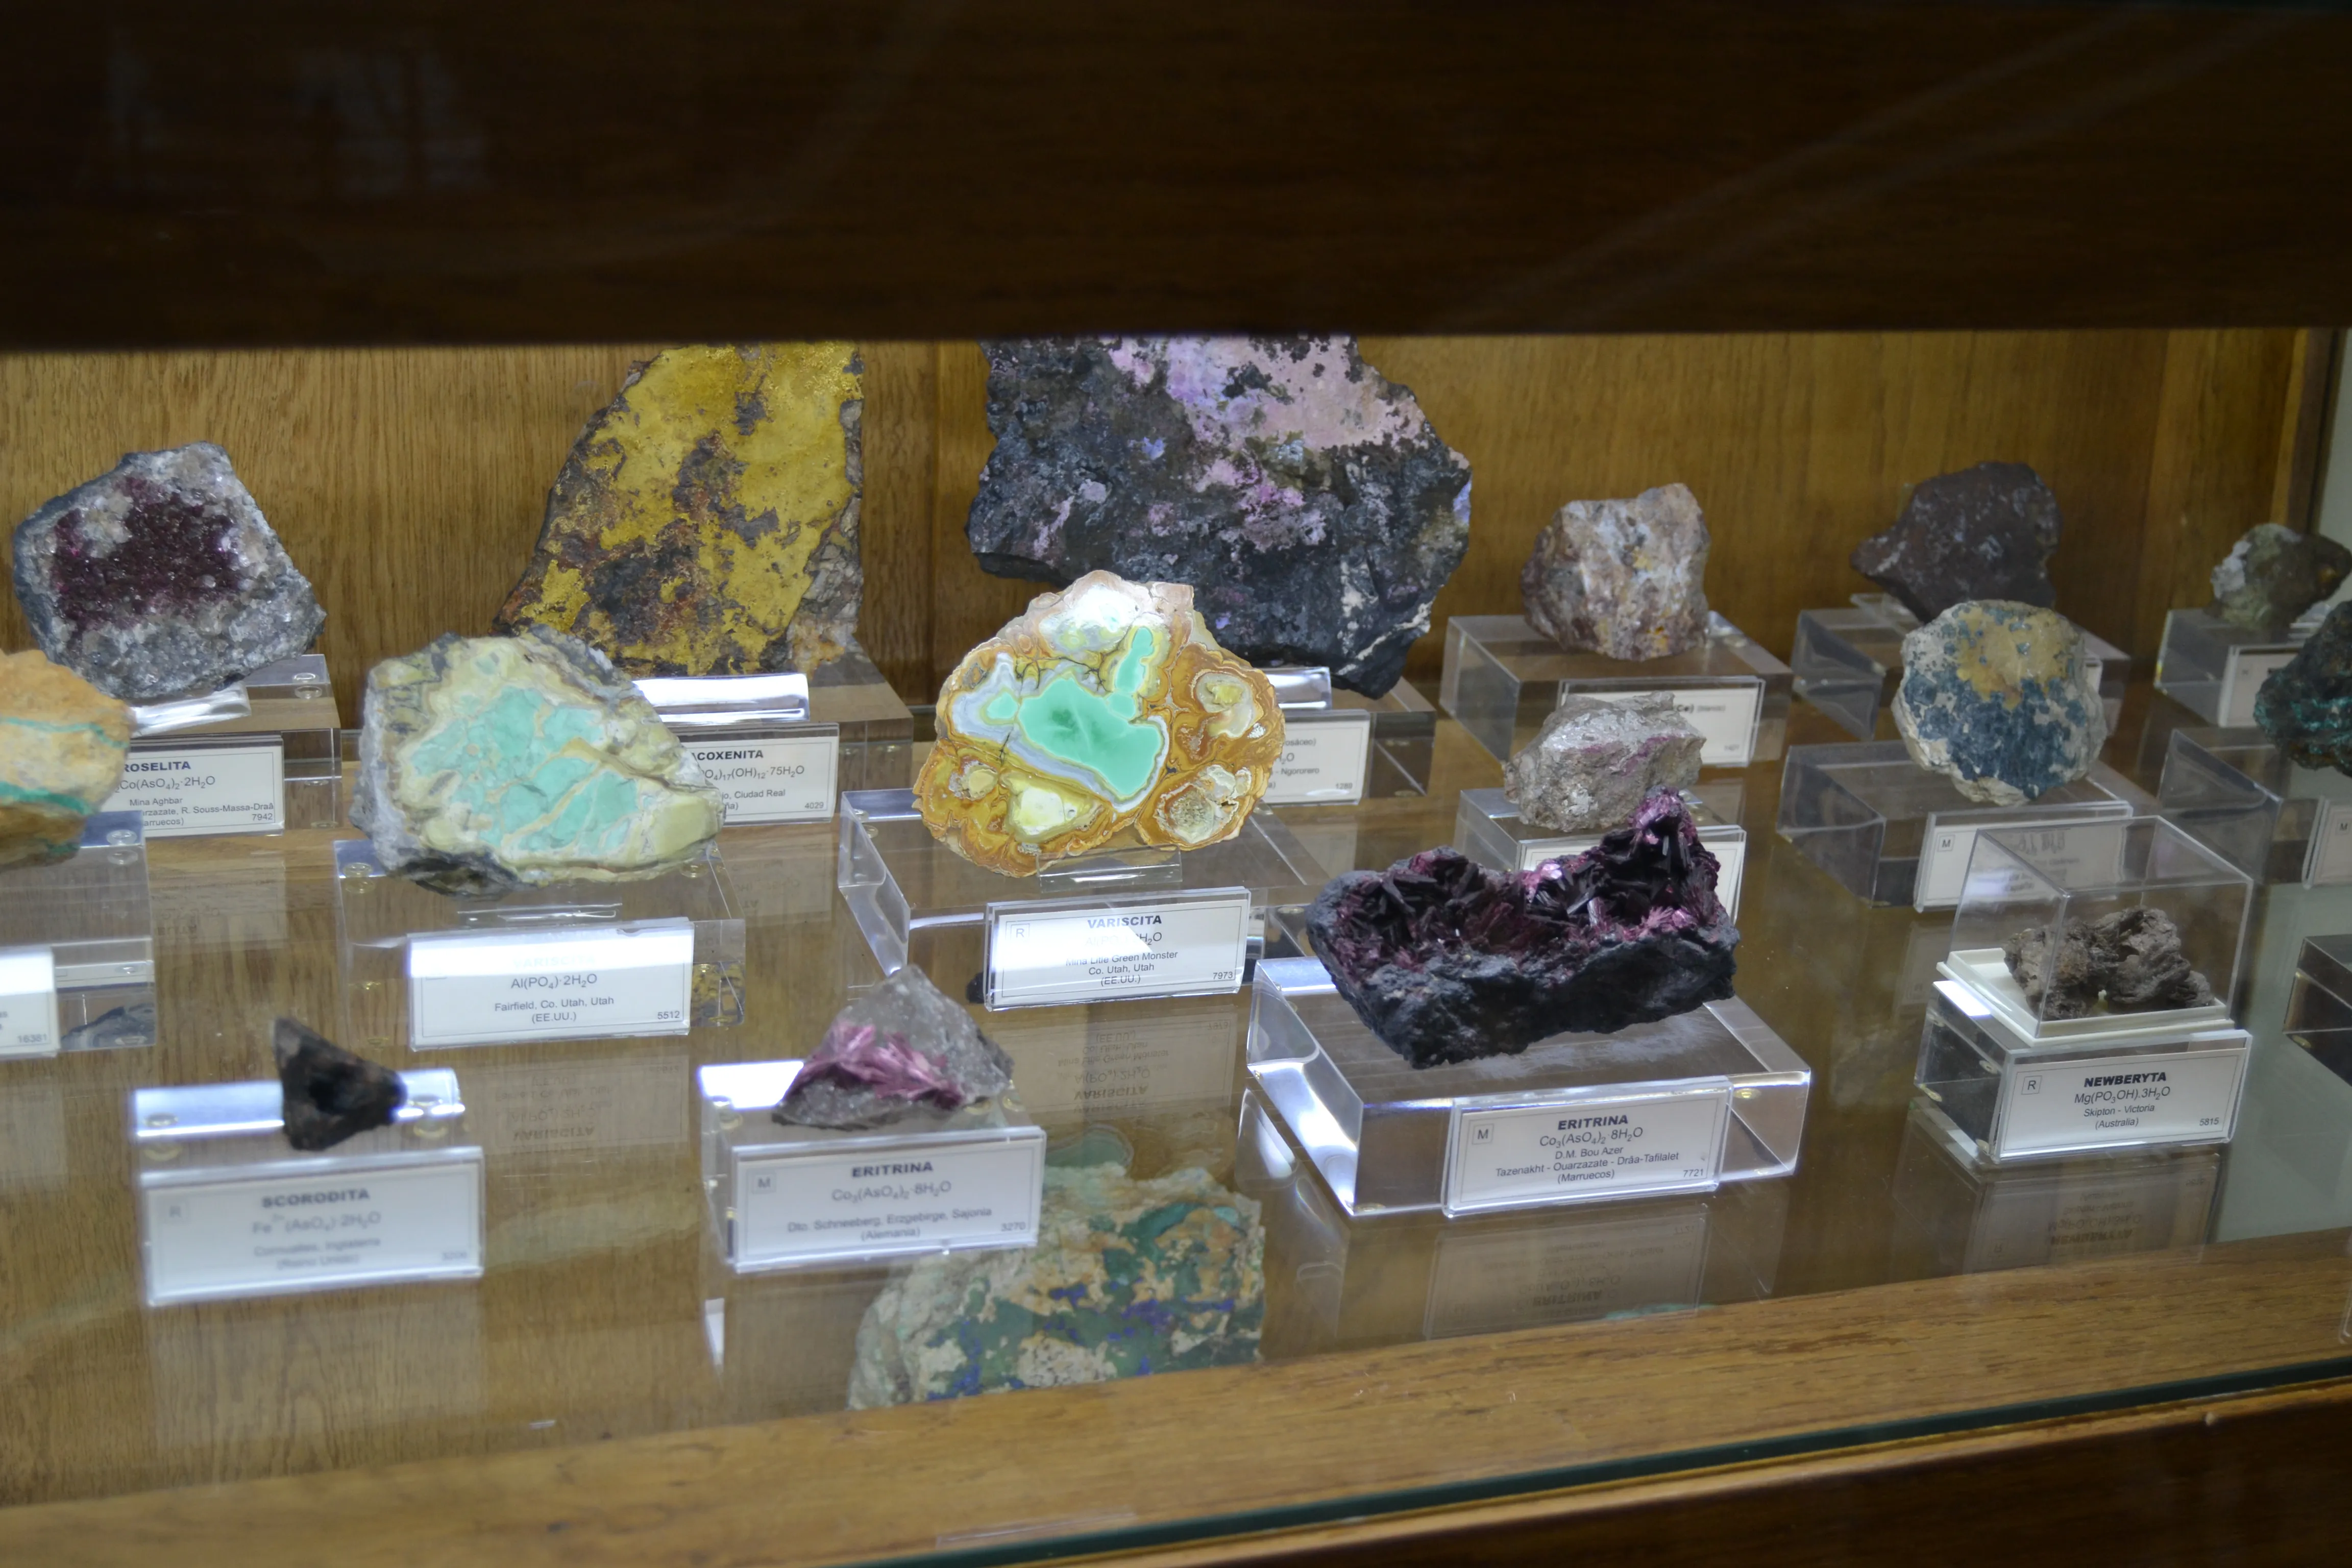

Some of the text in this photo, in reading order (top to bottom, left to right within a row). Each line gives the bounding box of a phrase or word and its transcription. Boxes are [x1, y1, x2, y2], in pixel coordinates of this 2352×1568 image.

[692, 750, 764, 761] COXENITA
[124, 761, 191, 772] ROSELITA
[734, 790, 764, 799] Ciudad
[766, 789, 786, 797] Real
[153, 797, 183, 806] Aghbar
[143, 817, 184, 826] arruecos)
[252, 813, 273, 821] 7942
[1942, 840, 1951, 848] M
[1087, 915, 1162, 928] VARISCITA
[1016, 928, 1024, 938] R
[1112, 954, 1139, 963] Green
[1142, 951, 1178, 961] Monster
[1089, 963, 1155, 975] Co. Utah, Utah
[1100, 974, 1141, 987] (EE.UU.)
[1213, 971, 1233, 980] 7973
[495, 996, 614, 1012] Fairfield, Co. Utah, Utah
[531, 1012, 577, 1024] (EE.UU.)
[657, 1010, 680, 1020] 5512
[2027, 1080, 2036, 1090] R
[2084, 1072, 2167, 1087] NEWBERYTA
[2084, 1107, 2115, 1118] Skipton
[2124, 1104, 2154, 1113] Victoria
[1558, 1115, 1629, 1131] ERITRINA
[2095, 1118, 2139, 1130] (Australia)
[2199, 1118, 2219, 1126] 5815
[1477, 1129, 1489, 1140] M
[1555, 1146, 1624, 1159] D.M. Bou Azer
[851, 1162, 934, 1178] ERITRINA
[1496, 1164, 1545, 1177] Tazenakht
[1554, 1160, 1608, 1171] Ouarzazate
[1683, 1169, 1704, 1178] 7721
[1558, 1169, 1615, 1184] (Marruecos)
[758, 1178, 771, 1189] M
[262, 1188, 371, 1208] SCORODITA
[952, 1207, 992, 1220] Sajonia
